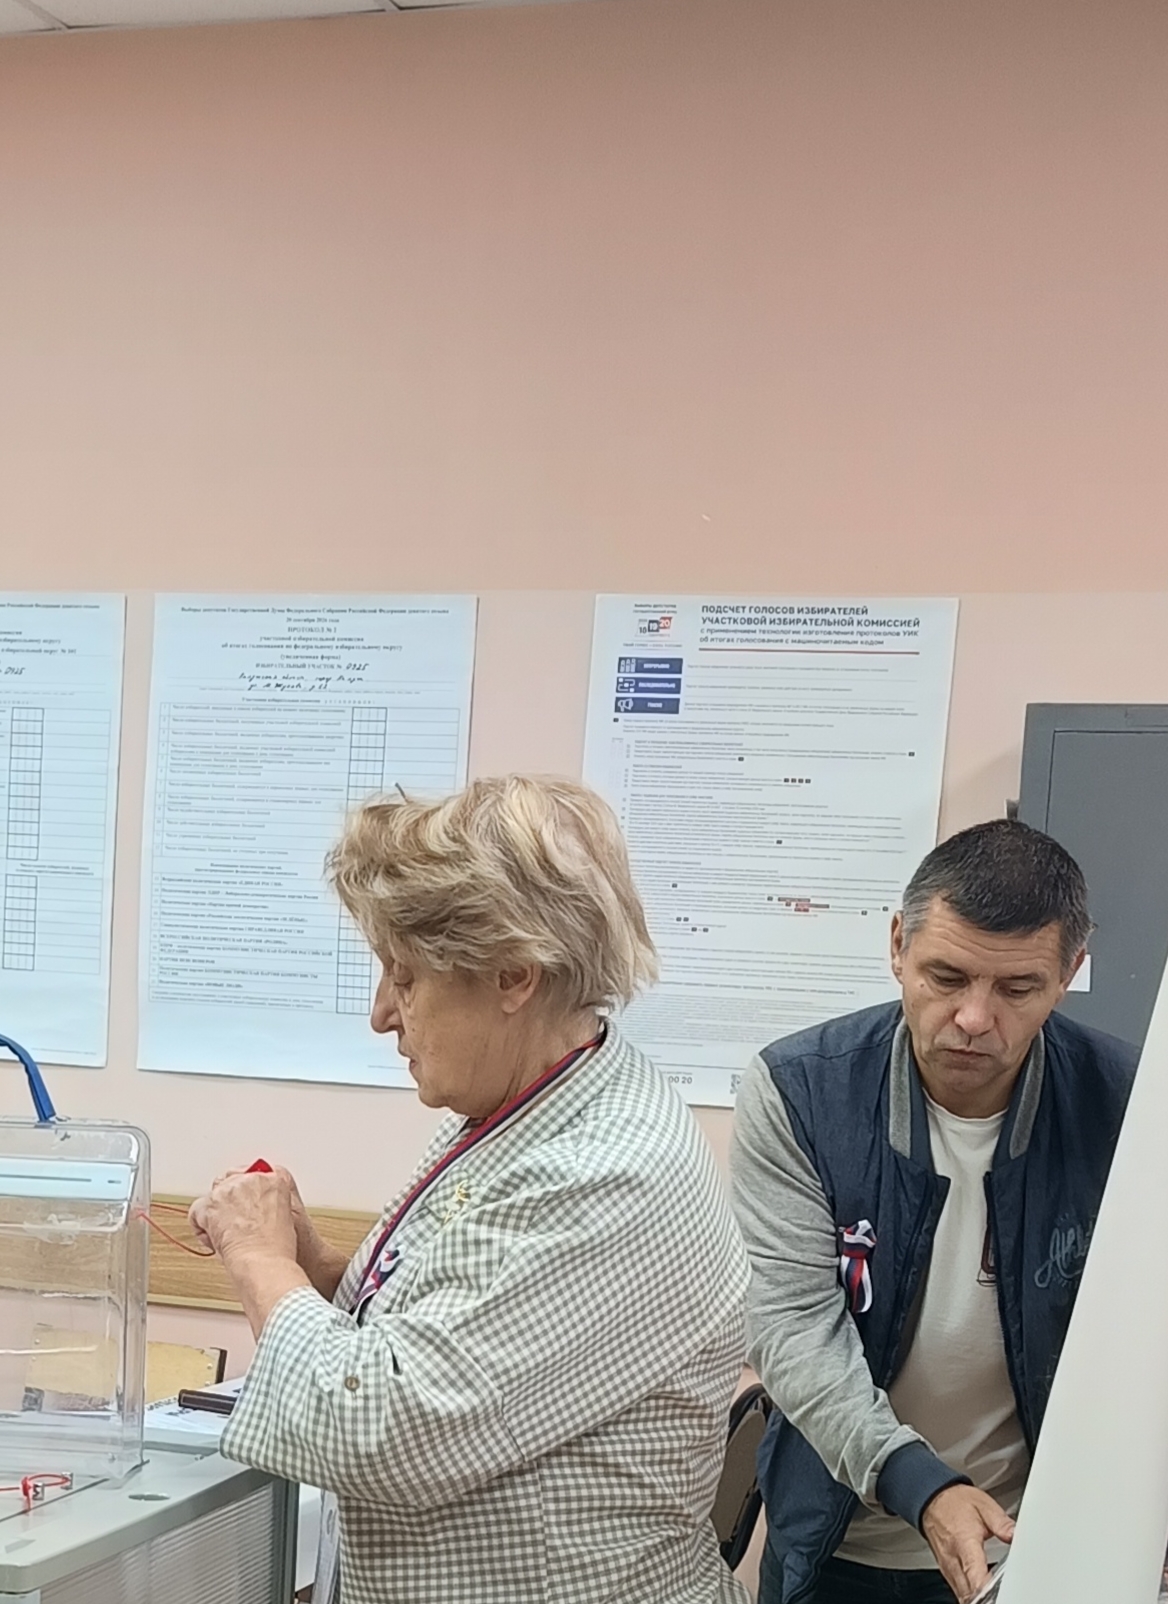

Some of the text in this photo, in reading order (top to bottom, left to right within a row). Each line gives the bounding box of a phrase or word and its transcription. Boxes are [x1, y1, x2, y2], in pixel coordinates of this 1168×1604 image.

[701, 605, 868, 615] ПОДСЧЕТ ГОЛОСОВ ИЗБИРАТЕЛЕЙ
[659, 619, 670, 628] 20
[701, 615, 920, 628] УЧАСТКОВОЙ ИЗБИРАТЕЛЬНОЙ КОМИССИЕЙ
